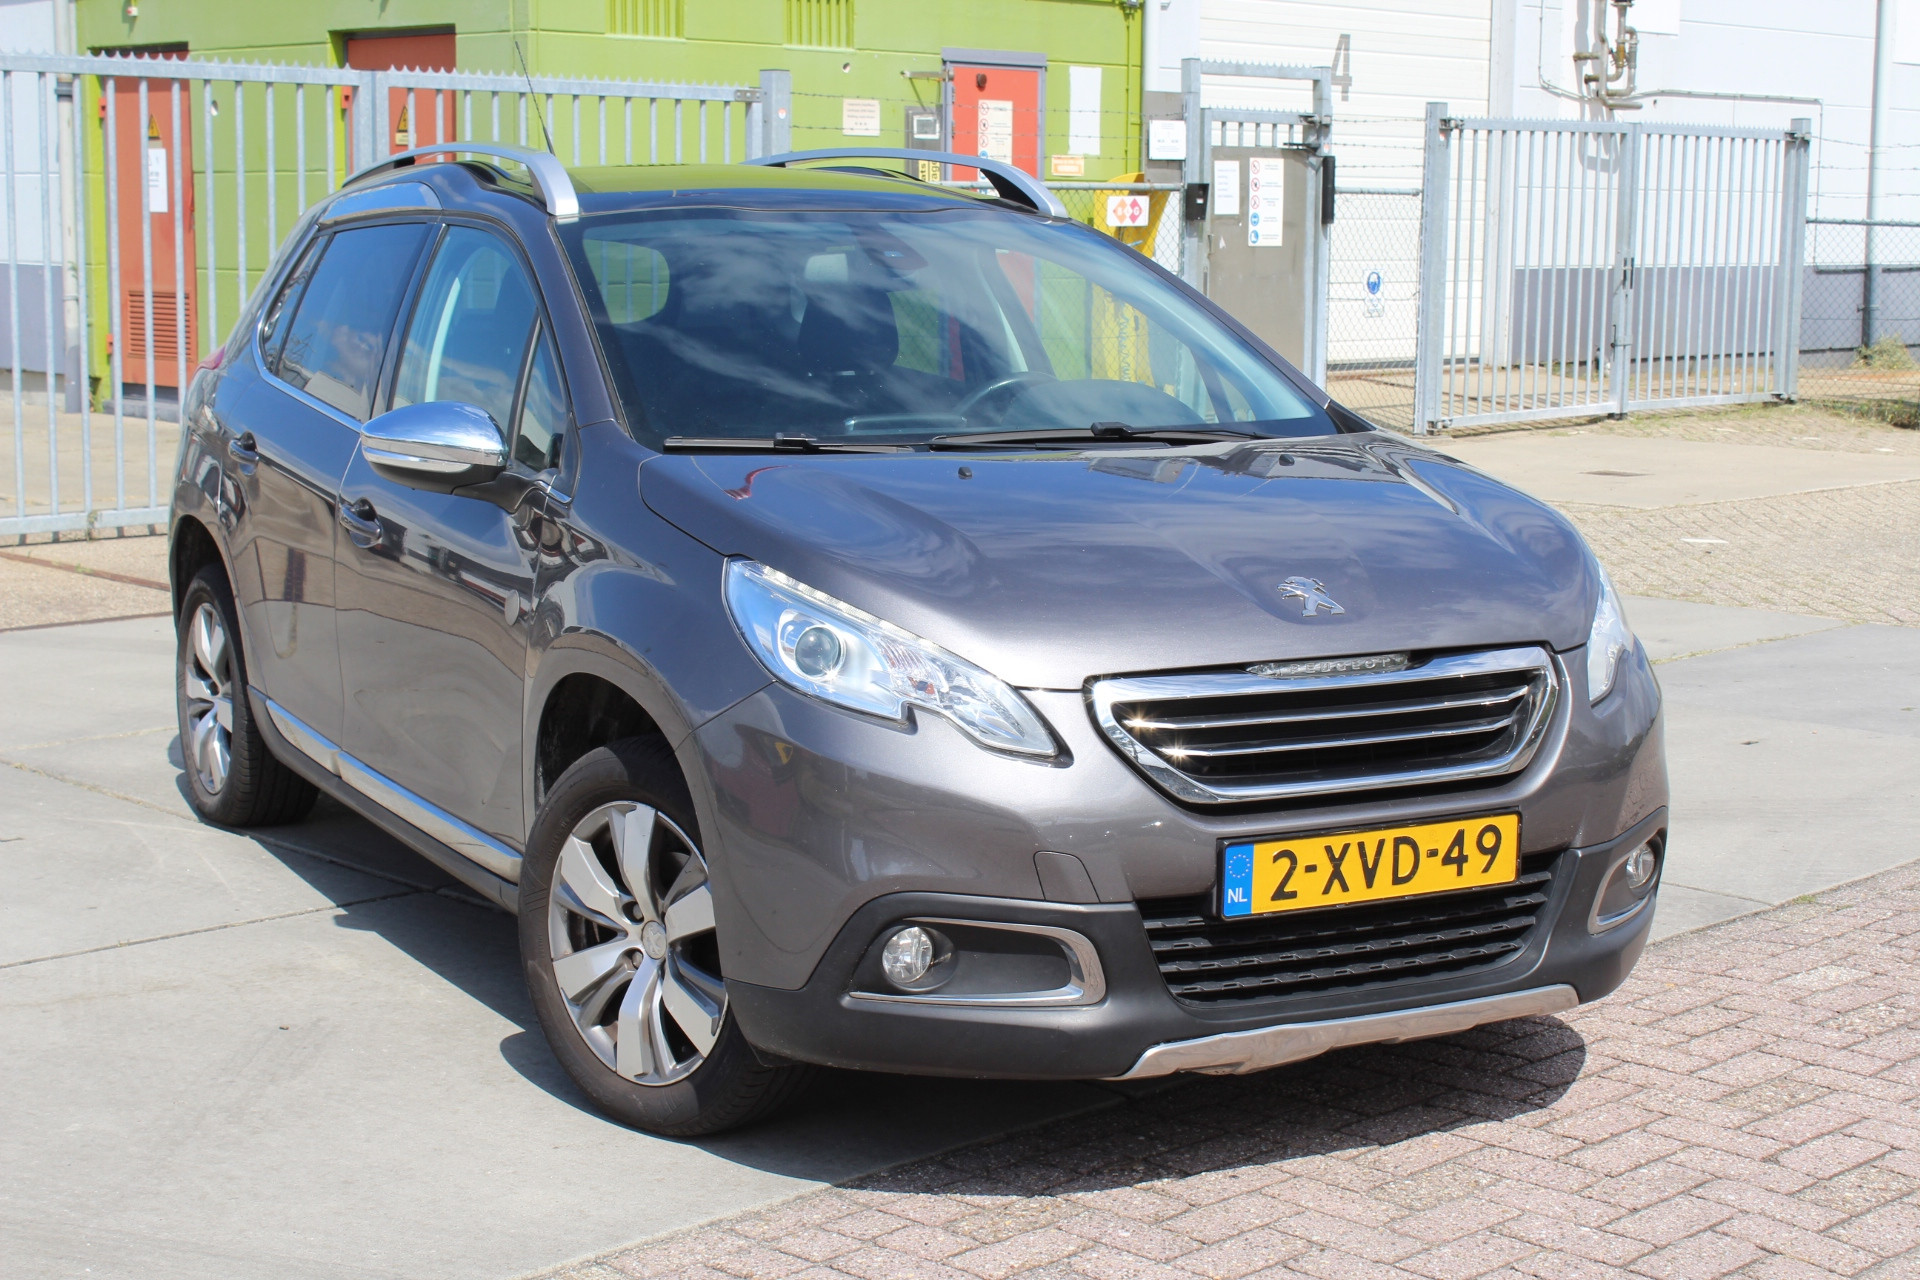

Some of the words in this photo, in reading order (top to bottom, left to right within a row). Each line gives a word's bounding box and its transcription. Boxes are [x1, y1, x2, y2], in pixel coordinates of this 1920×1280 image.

[1331, 33, 1352, 102] 4
[1290, 655, 1391, 674] PEUGEOT
[1270, 823, 1502, 902] 2-XVD-49
[1227, 887, 1248, 904] NL
